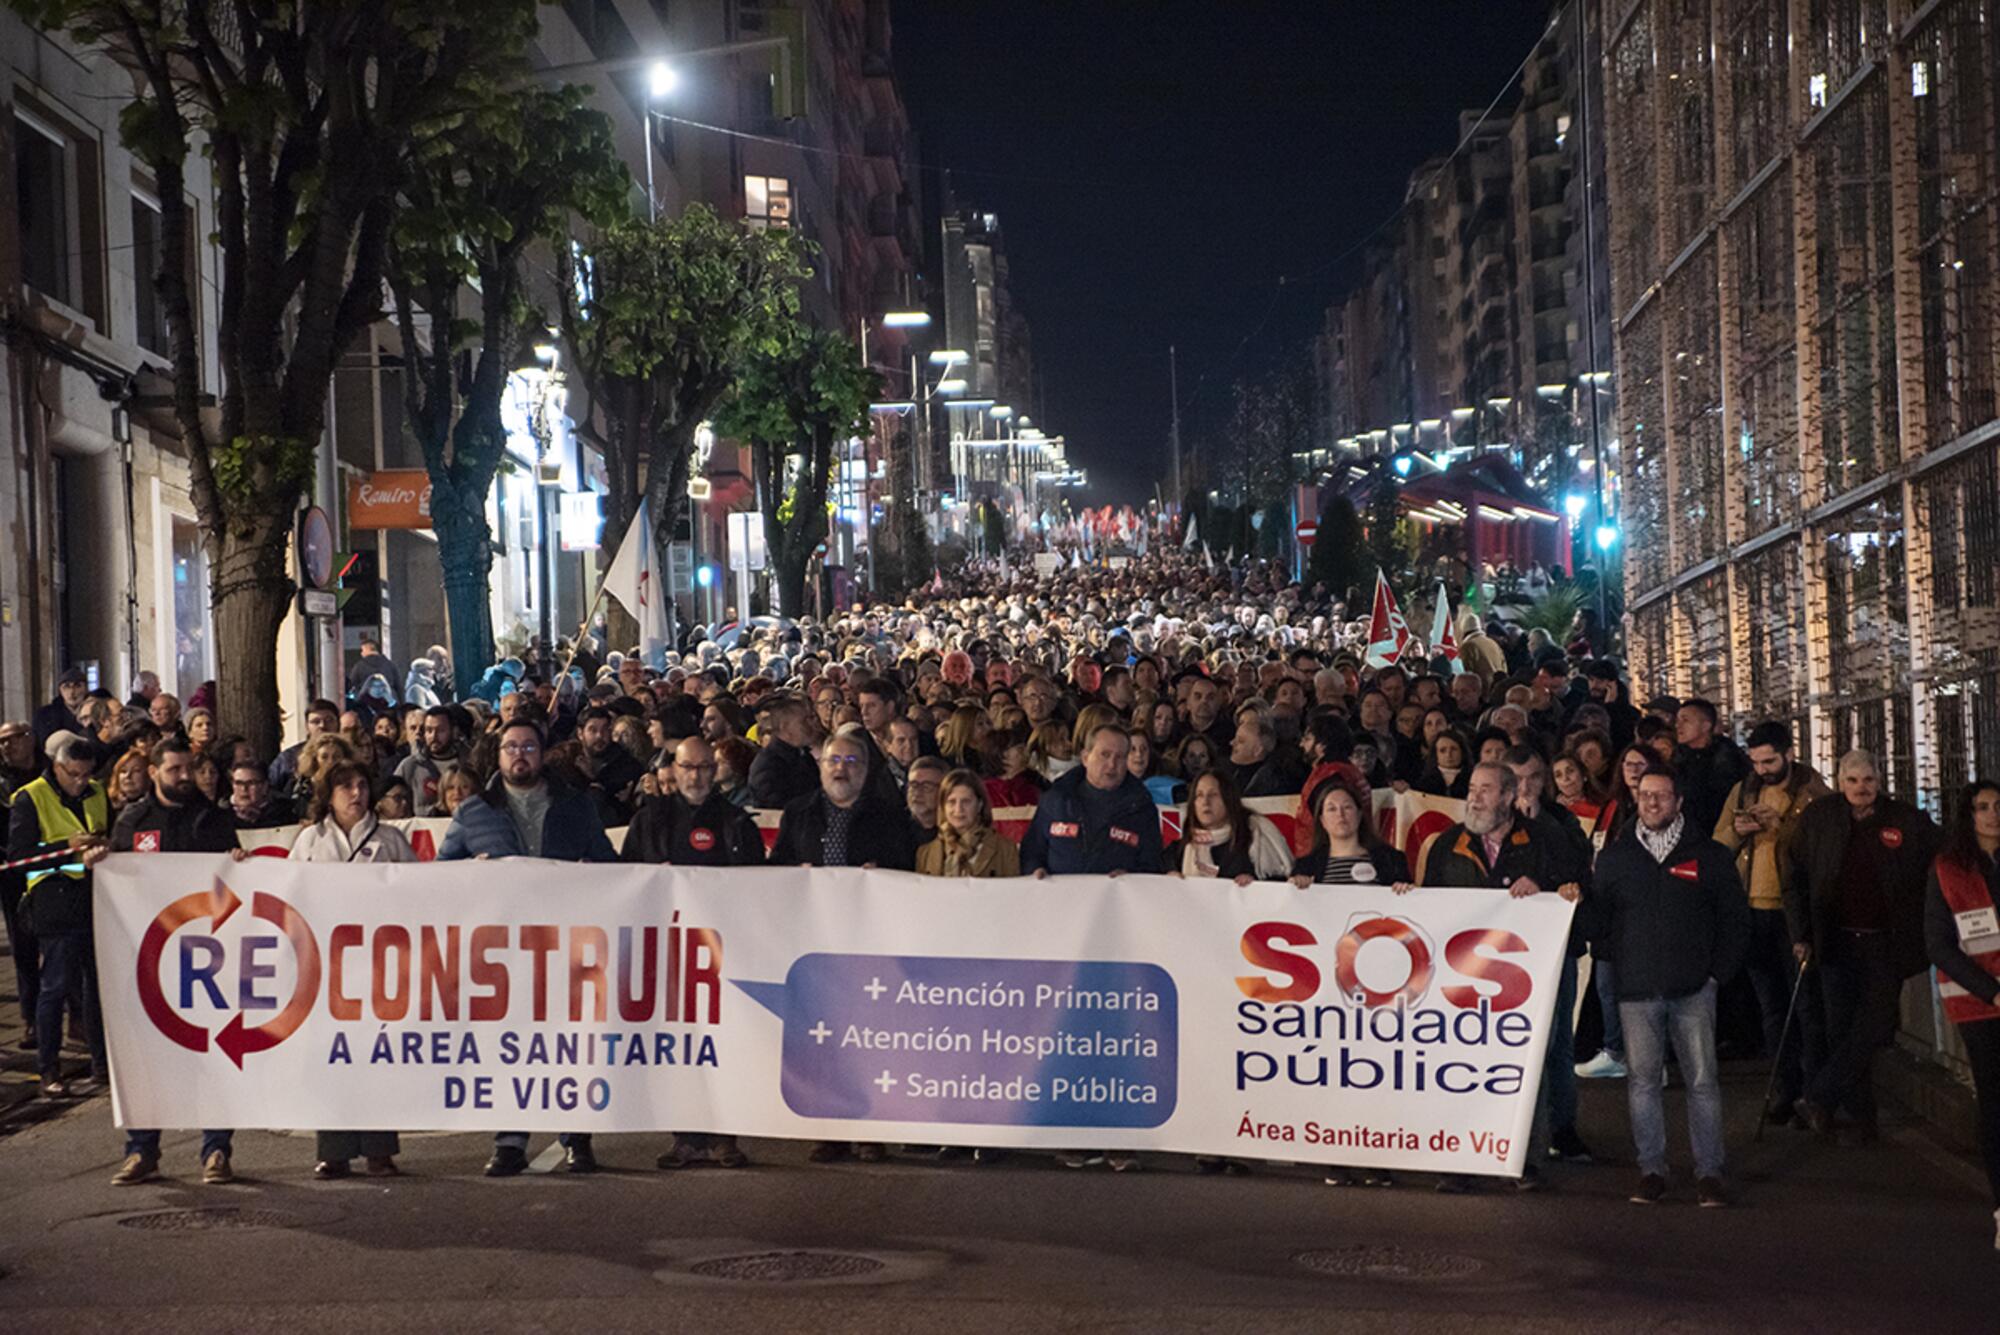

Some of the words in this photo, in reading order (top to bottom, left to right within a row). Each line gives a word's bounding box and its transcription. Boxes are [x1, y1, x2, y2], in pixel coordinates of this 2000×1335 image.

[357, 484, 416, 506] Ramiro
[179, 934, 278, 1010] RE
[328, 909, 723, 1025] CONSTRUÍR
[1234, 911, 1532, 1012] SOS
[895, 979, 1025, 1008] Atención
[1035, 983, 1160, 1012] Primaria
[840, 1024, 971, 1053] Atención
[981, 1029, 1159, 1060] Hospitalaria
[1236, 995, 1533, 1048] sanidade
[328, 1032, 353, 1064] A
[369, 1023, 481, 1065] ÁREA
[499, 1031, 719, 1068] SANITARIA
[906, 1072, 1042, 1101] Sanidade
[1051, 1076, 1158, 1104] Pública
[1236, 1044, 1525, 1096] pública
[444, 1076, 494, 1110] DE
[512, 1076, 611, 1112] VIGO
[1236, 1110, 1296, 1143] Área
[1303, 1120, 1420, 1151] Sanitaria
[1428, 1130, 1461, 1153] de
[1468, 1131, 1511, 1161] Vig
